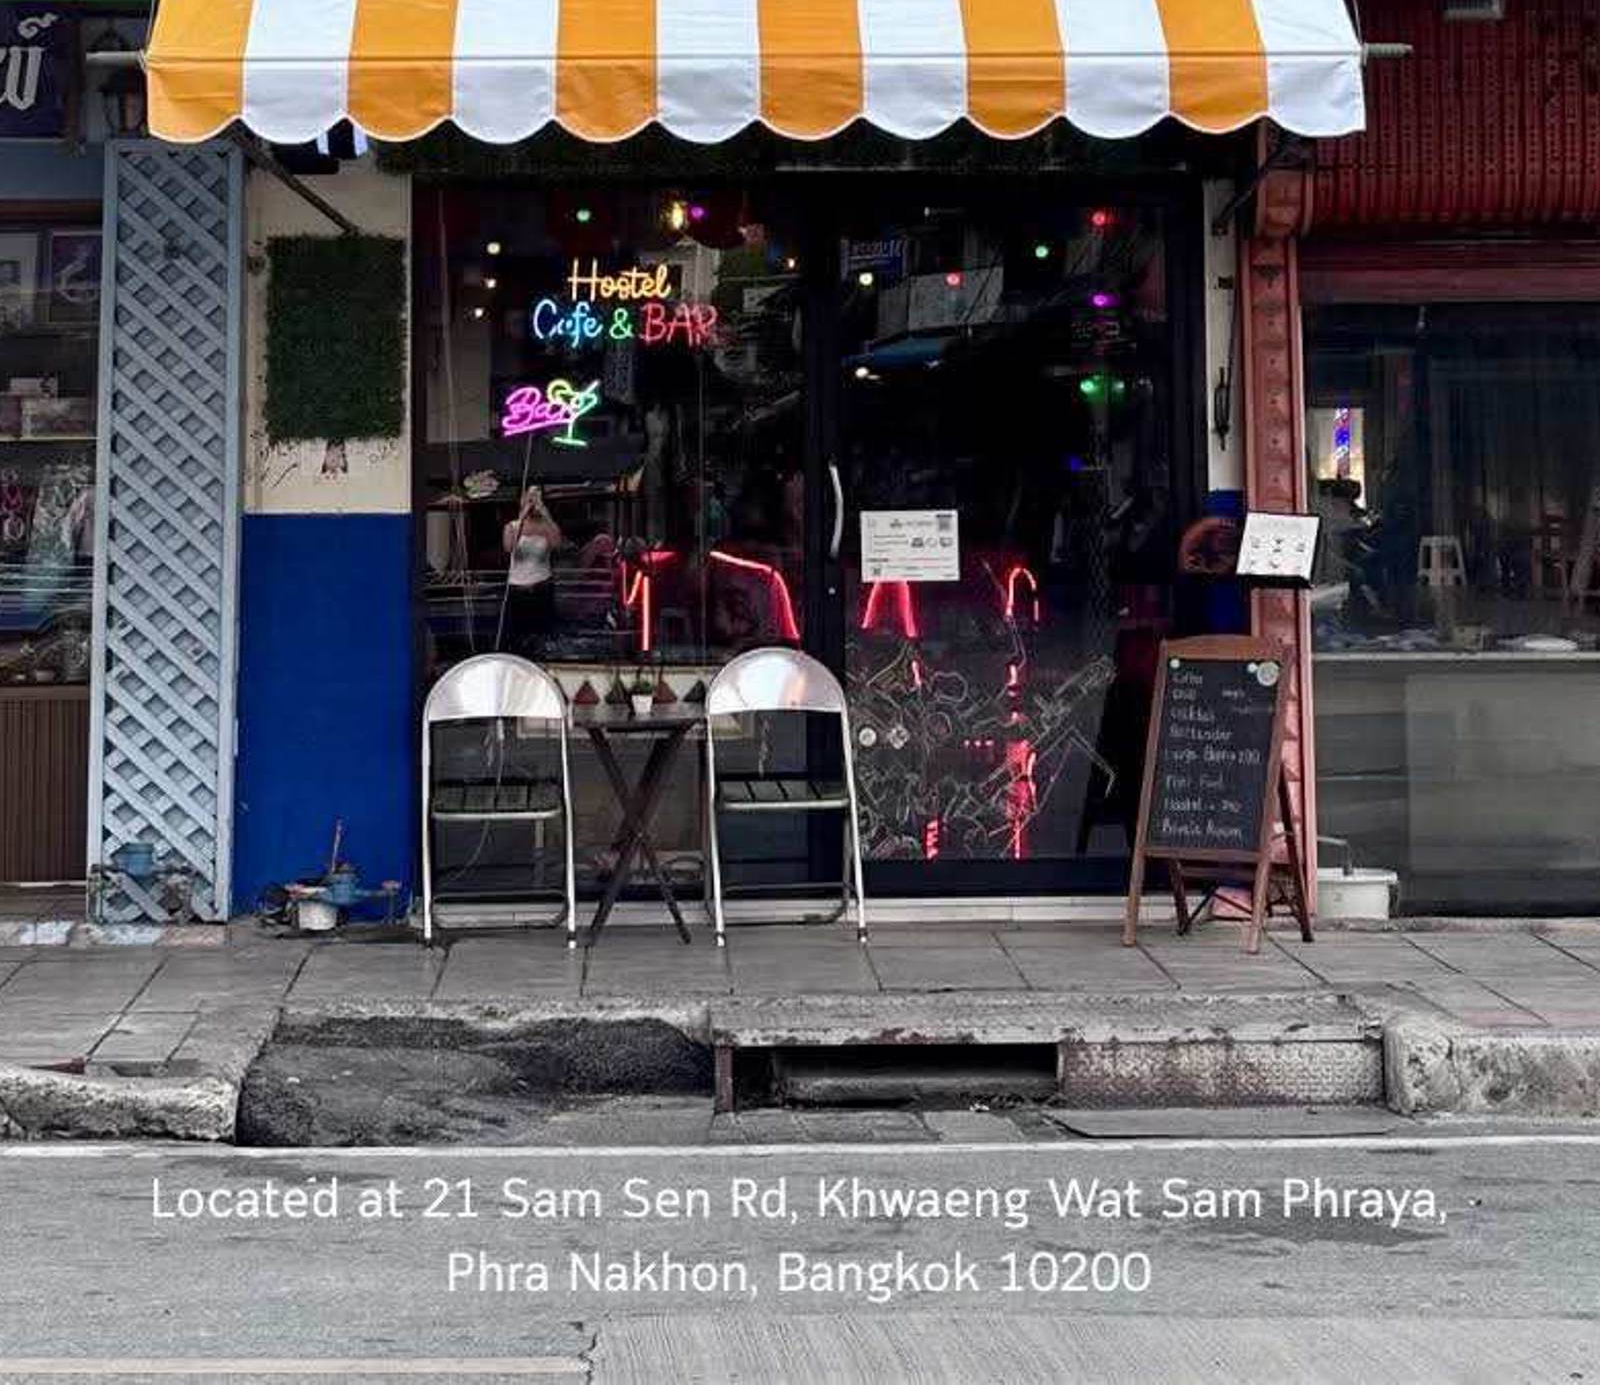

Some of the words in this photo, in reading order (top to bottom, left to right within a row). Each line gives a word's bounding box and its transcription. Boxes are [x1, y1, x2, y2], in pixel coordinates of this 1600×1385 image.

[567, 257, 673, 303] Hostel
[608, 306, 635, 341] &
[639, 300, 719, 347] BAR
